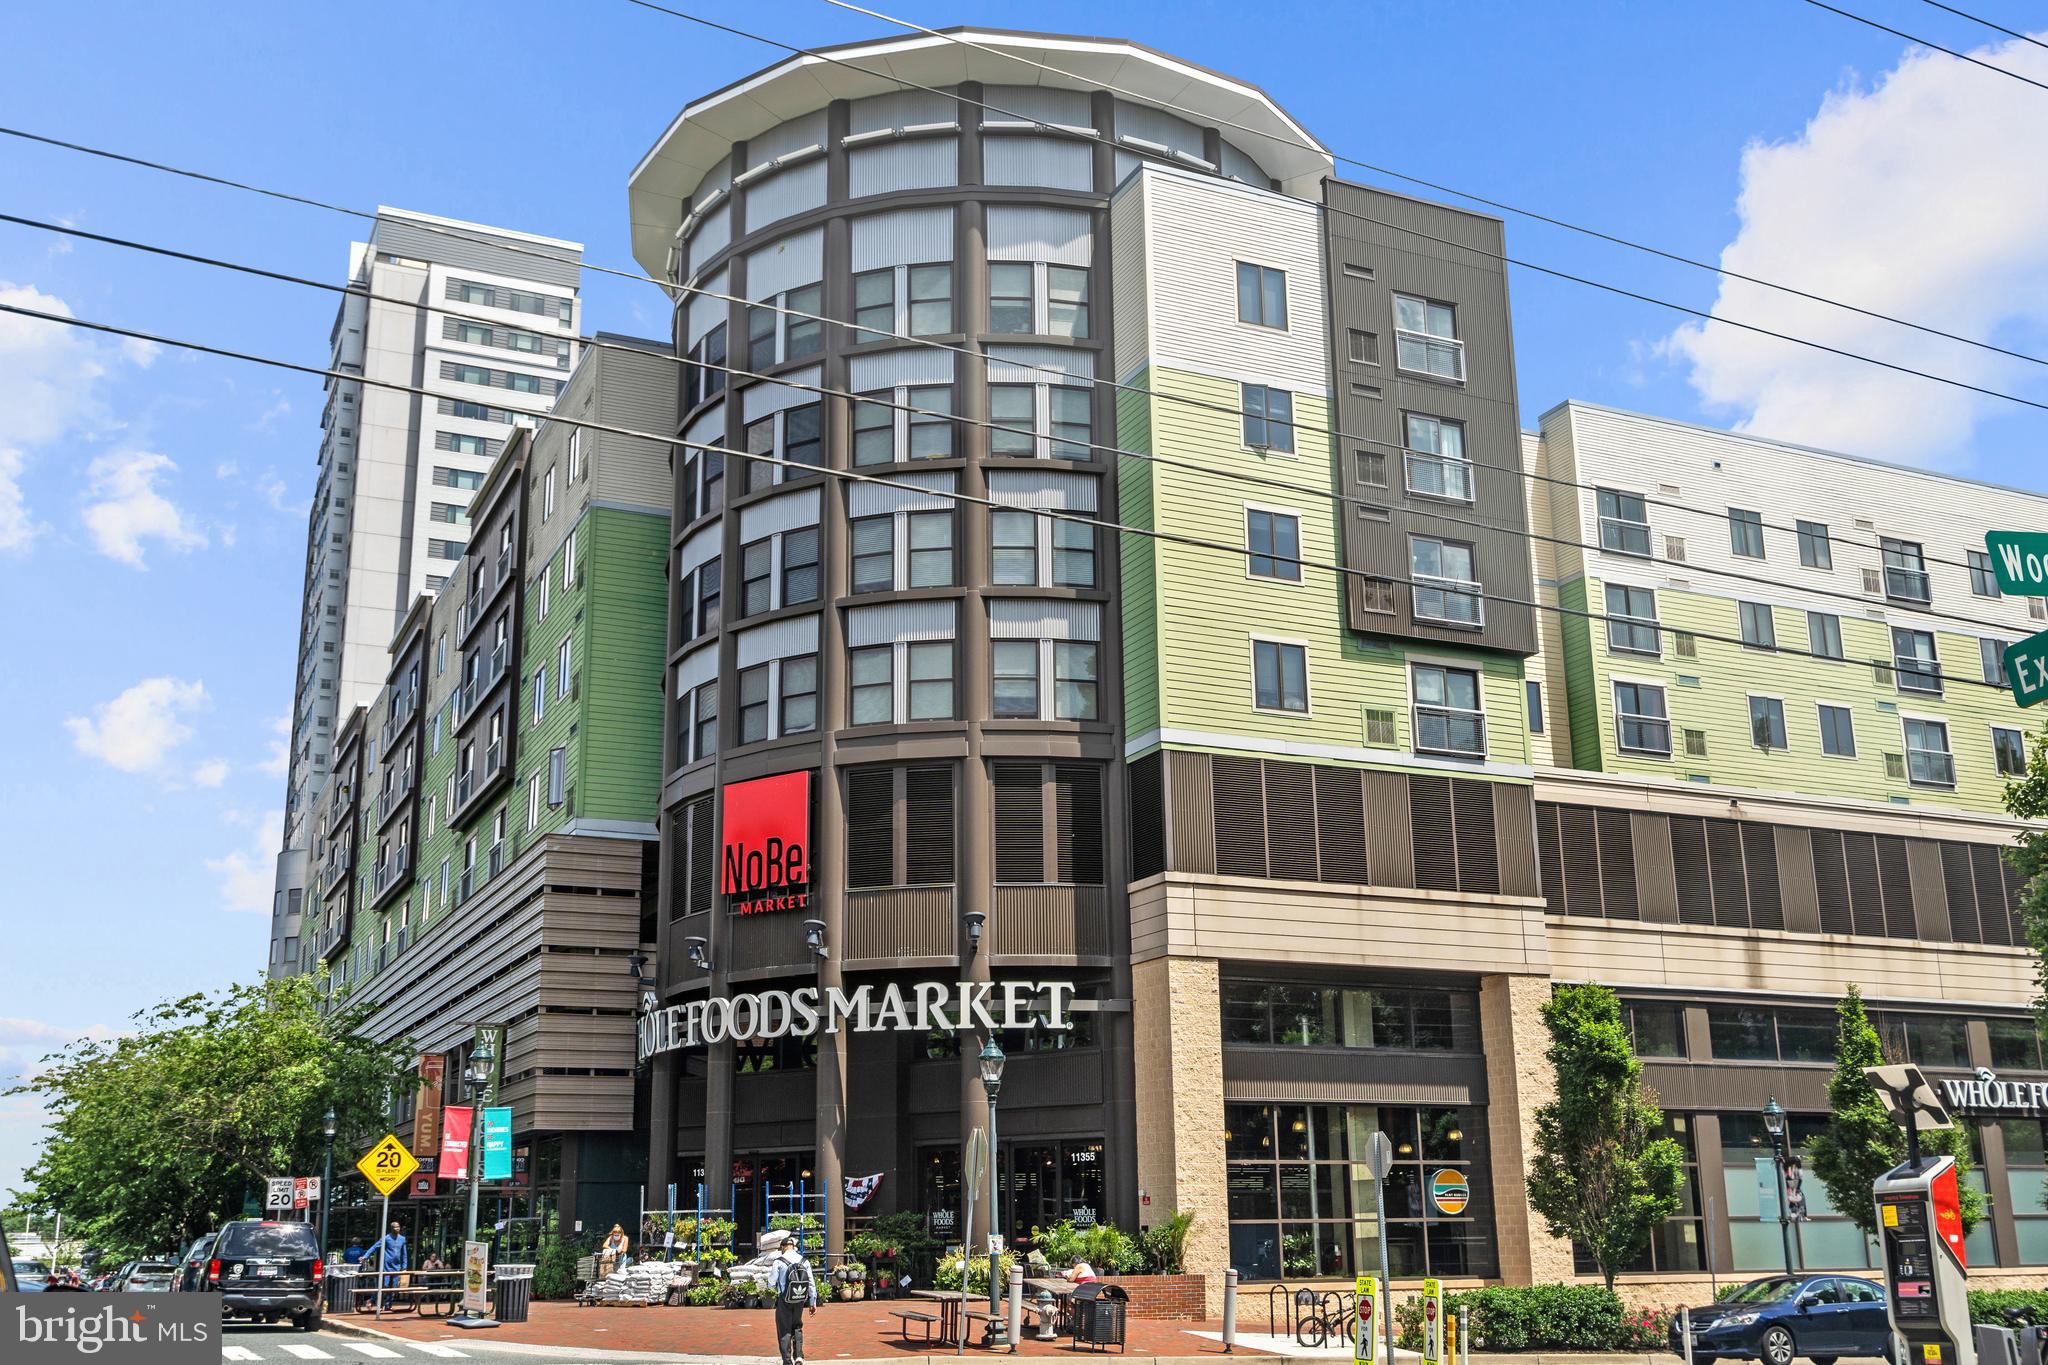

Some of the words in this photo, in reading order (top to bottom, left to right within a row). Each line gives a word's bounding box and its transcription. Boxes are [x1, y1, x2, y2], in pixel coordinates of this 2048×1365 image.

[1998, 543, 2048, 584] Wo
[725, 836, 804, 895] NoBe
[740, 894, 807, 915] MARKET
[636, 998, 684, 1062] HOLE
[685, 987, 820, 1044] FOODS
[824, 980, 1075, 1034] MARKET
[1939, 1078, 2029, 1110] WHOLE
[376, 1152, 401, 1168] 20
[1071, 1152, 1096, 1162] 11355
[693, 1168, 705, 1177] 113
[270, 1194, 290, 1205] 20
[932, 1210, 954, 1219] WHOLE
[1072, 1208, 1097, 1216] WHOLE
[933, 1218, 954, 1226] FOODS
[1074, 1215, 1097, 1223] FOODS
[1425, 1281, 1437, 1289] STATE
[1360, 1305, 1372, 1314] STOP
